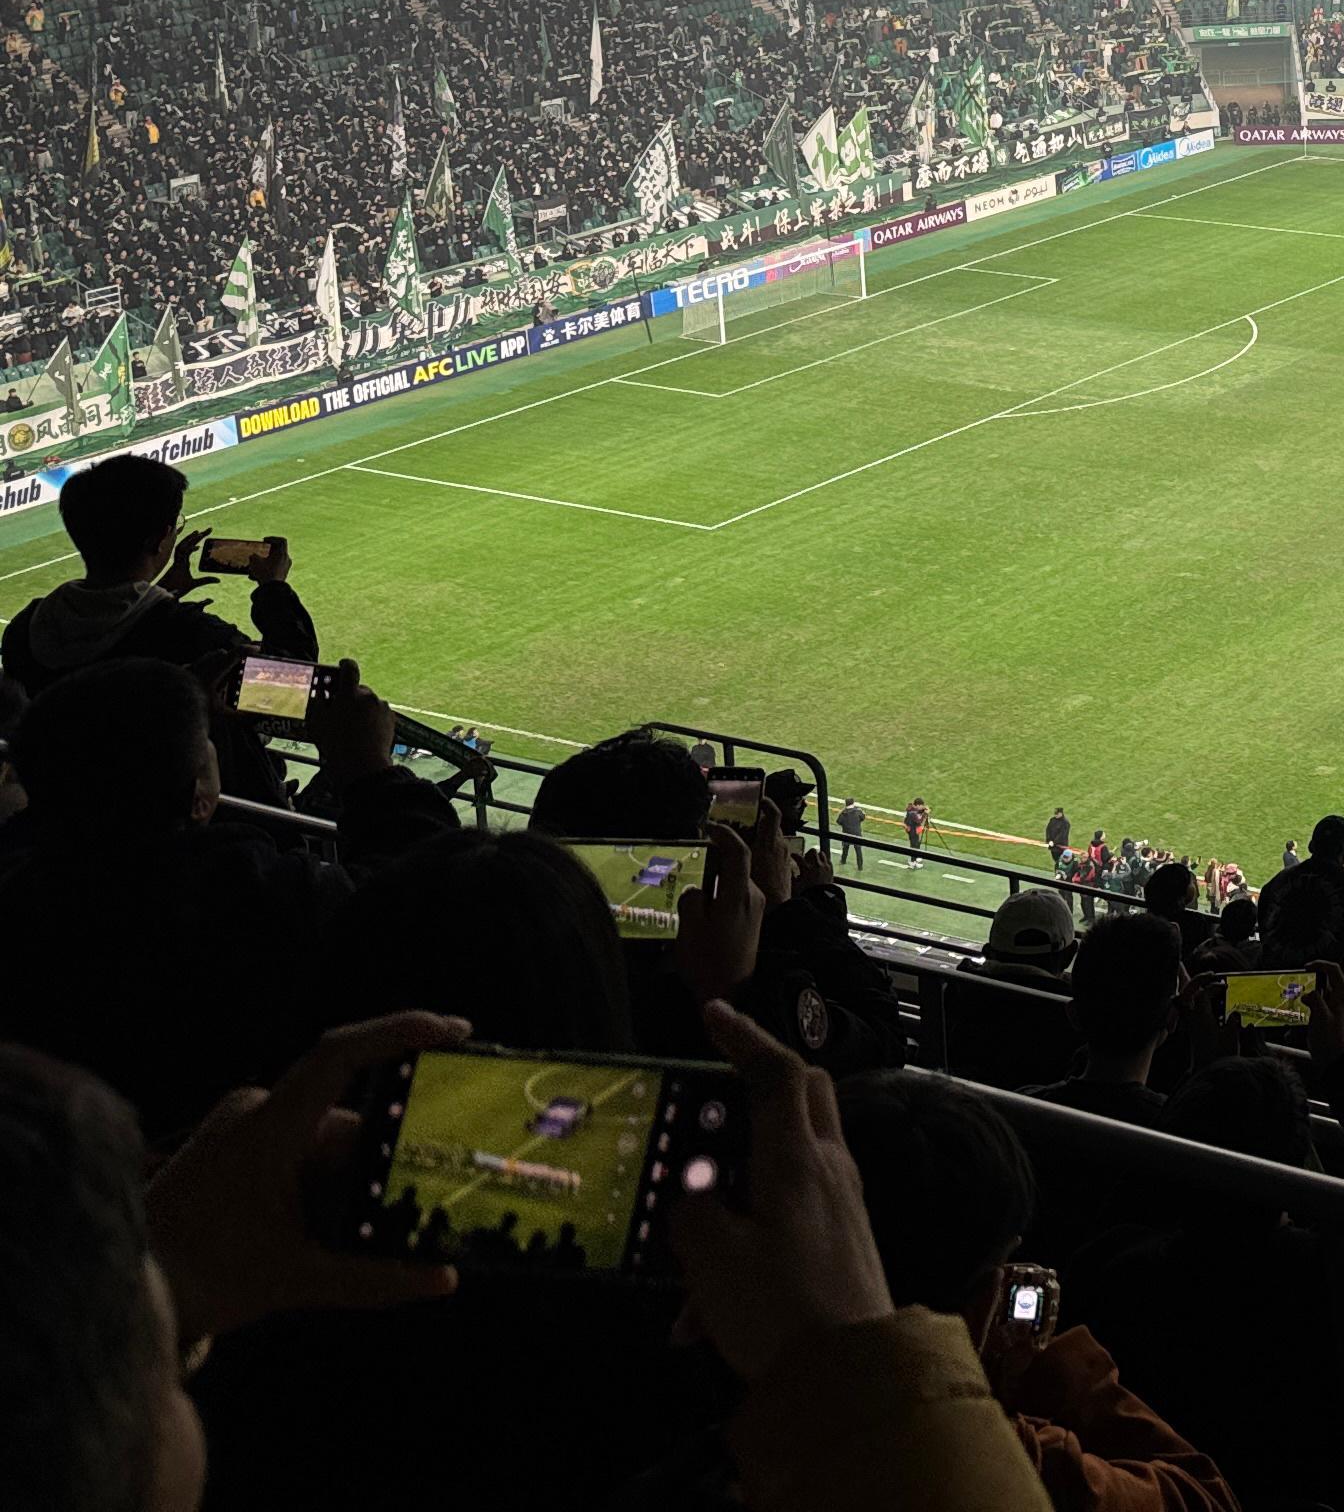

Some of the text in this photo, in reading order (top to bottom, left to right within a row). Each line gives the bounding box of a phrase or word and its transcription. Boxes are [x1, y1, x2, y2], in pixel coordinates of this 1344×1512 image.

[1239, 128, 1286, 143] QATAR
[974, 197, 1005, 214] NEOM
[873, 206, 965, 245] QATAR AIRWAYS
[669, 267, 750, 309] TECNO
[560, 301, 642, 341] 卡尔美体育
[239, 396, 320, 439] DOWNLOAD
[322, 390, 351, 413] THE
[353, 370, 411, 405] OFFICIAL
[412, 357, 455, 386] AFC
[455, 343, 499, 374] LIVE
[500, 335, 526, 360] APP
